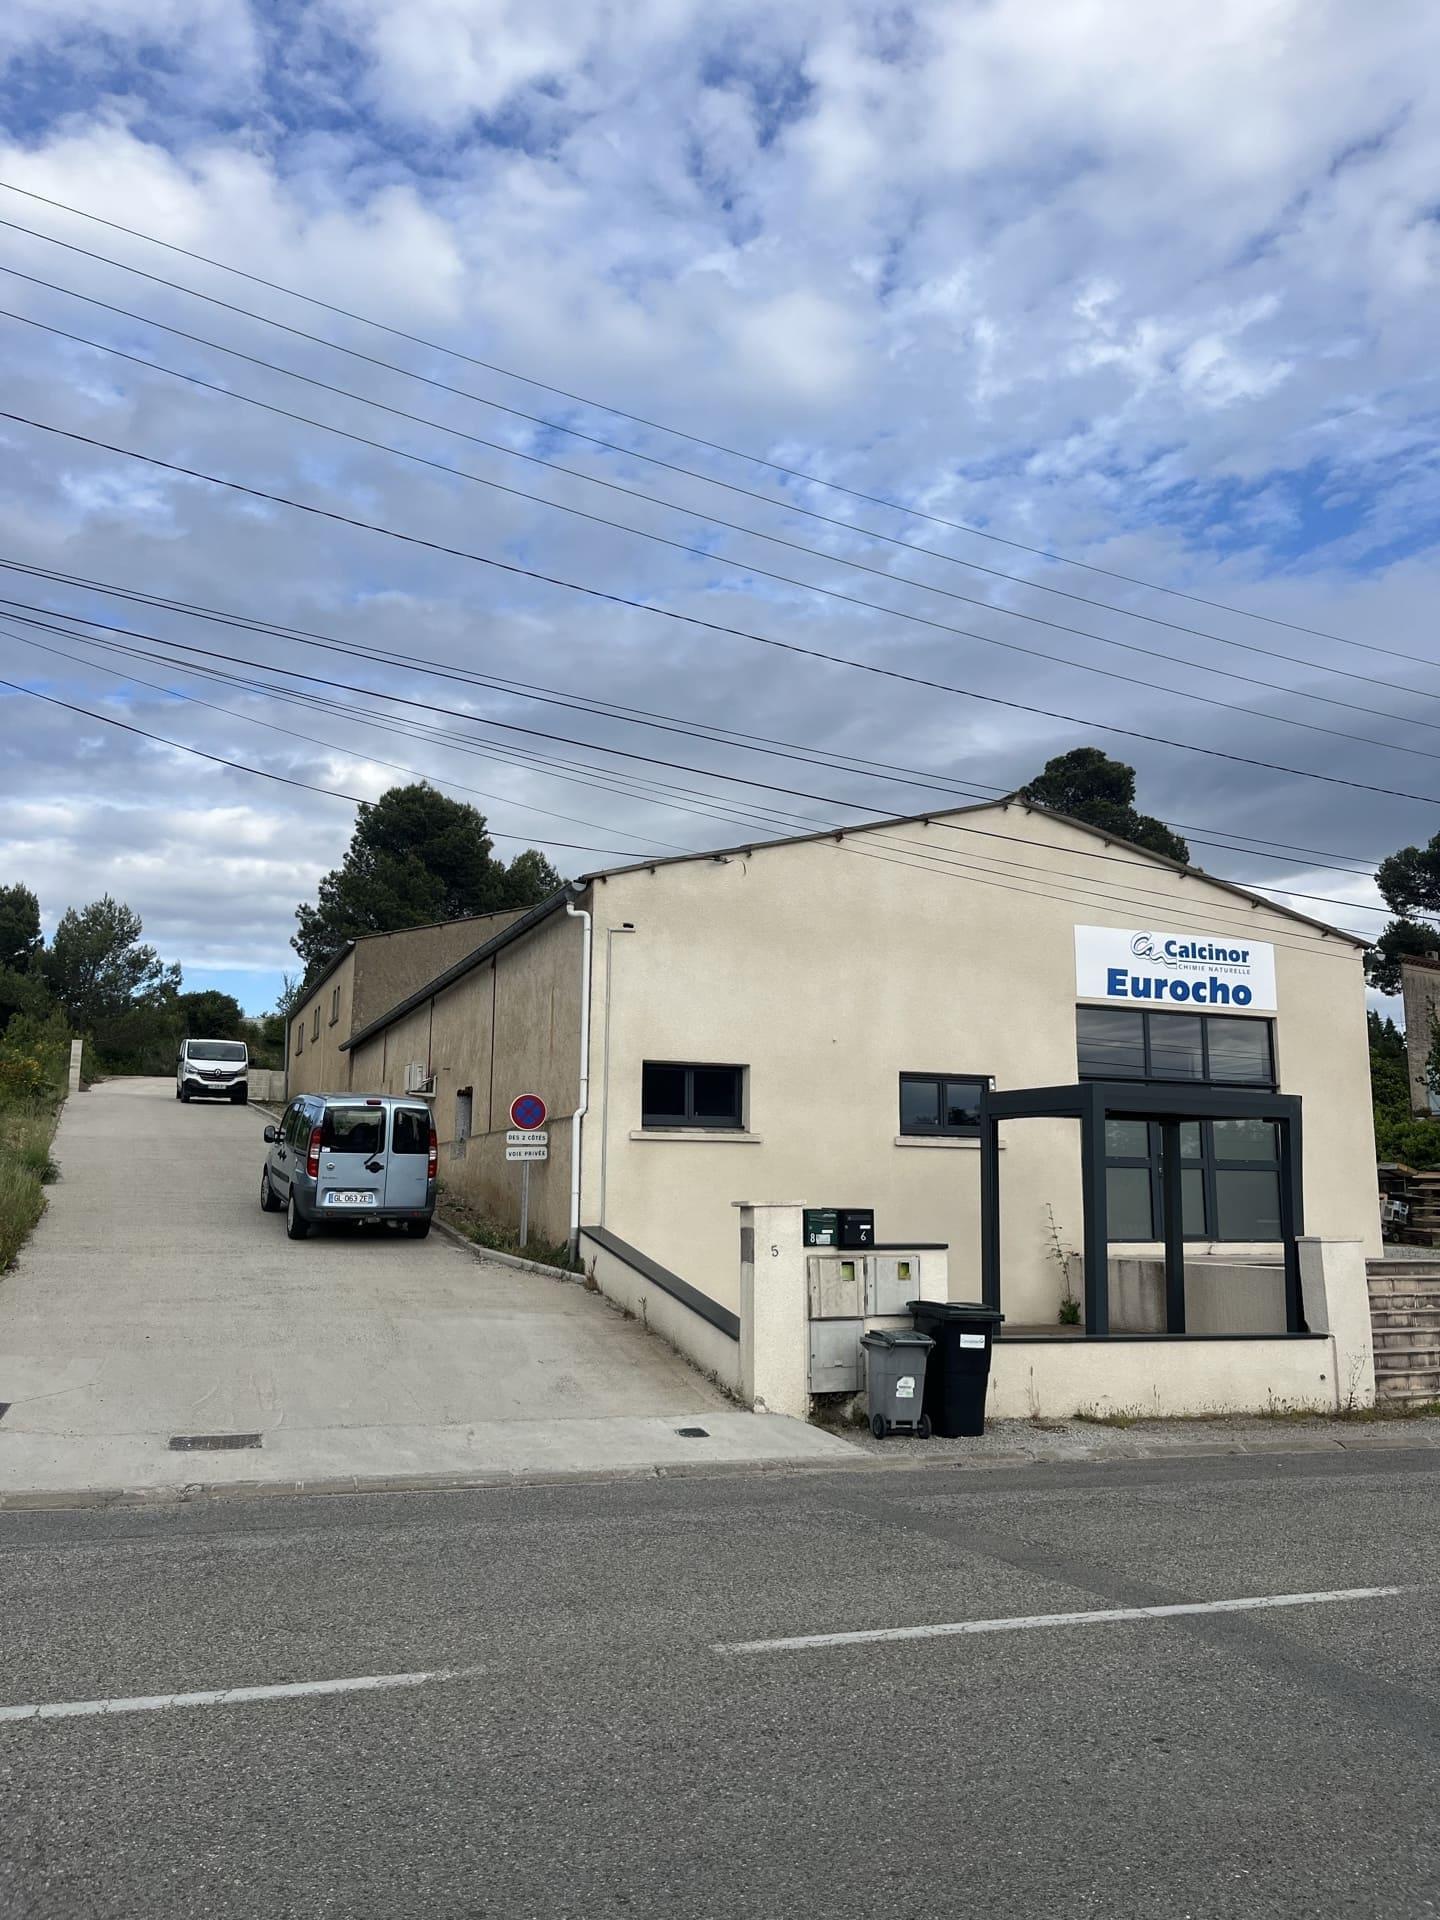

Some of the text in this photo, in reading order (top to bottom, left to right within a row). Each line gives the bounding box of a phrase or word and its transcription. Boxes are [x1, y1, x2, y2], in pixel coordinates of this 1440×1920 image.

[1164, 940, 1249, 963] Calcinor
[1208, 966, 1251, 975] NATURELLE
[1107, 968, 1252, 1006] Eurocho
[334, 1194, 343, 1202] GL
[810, 1232, 816, 1243] 8
[860, 1230, 867, 1241] 6
[771, 1245, 779, 1257] 5
